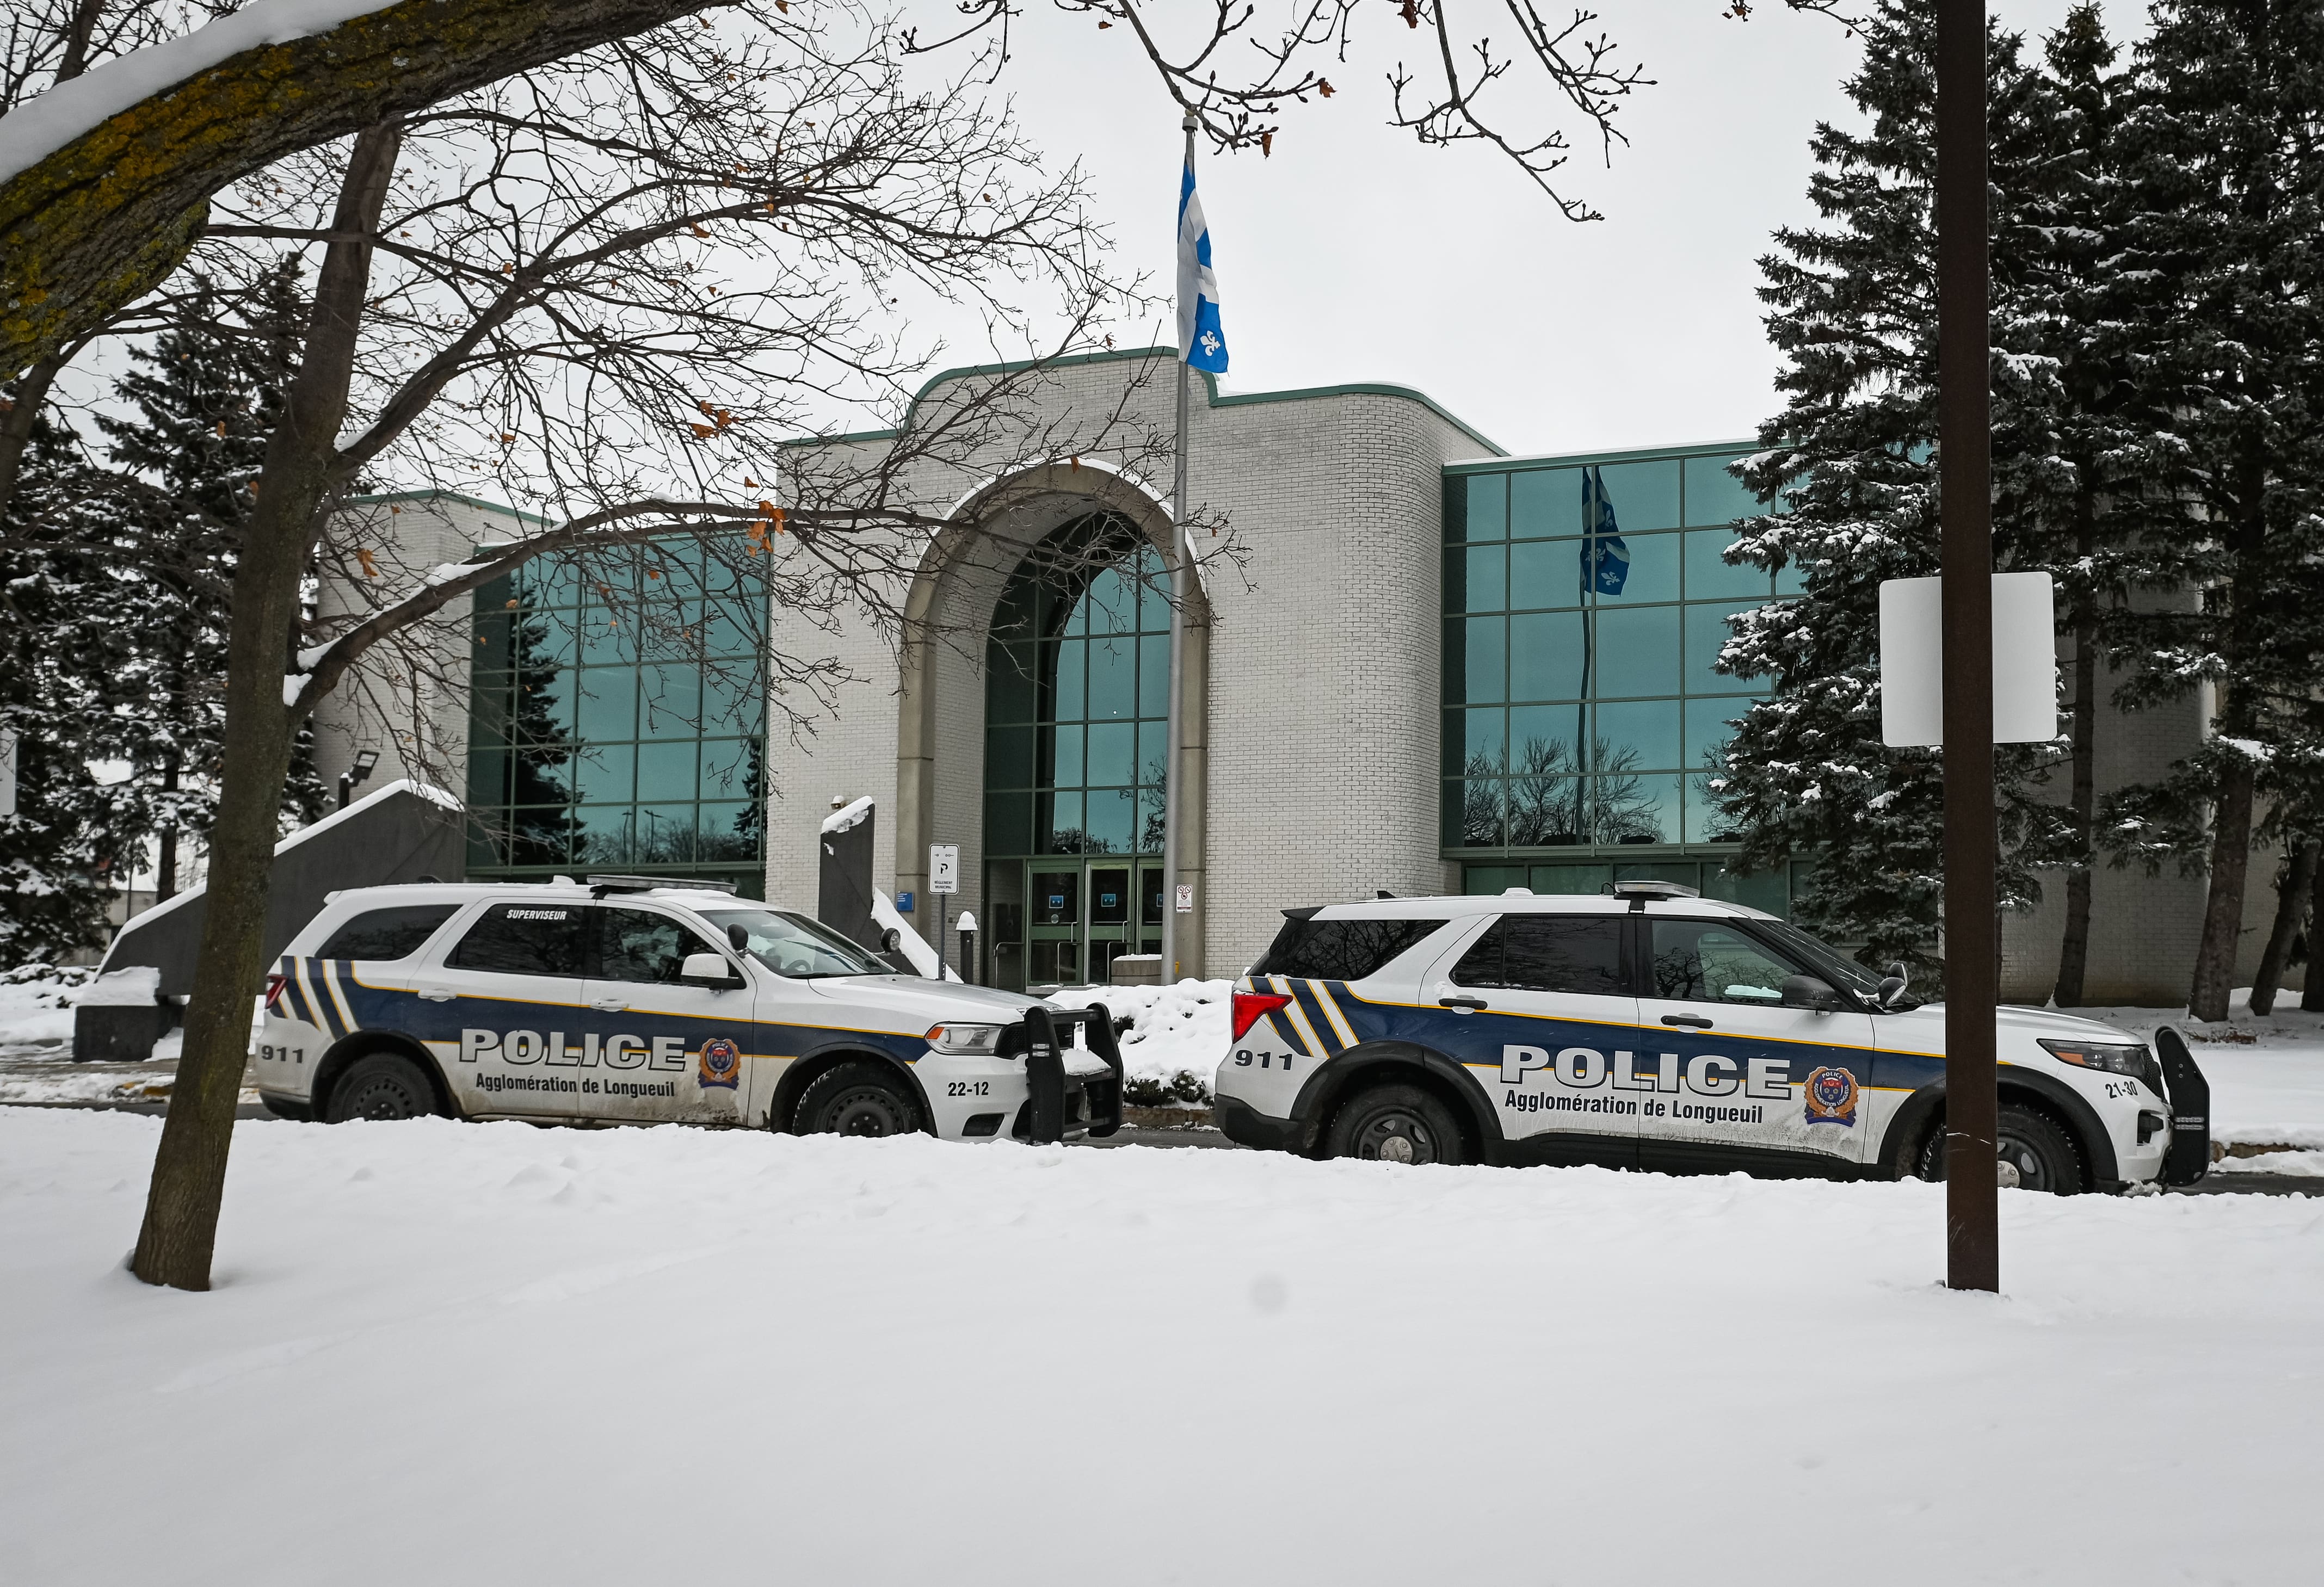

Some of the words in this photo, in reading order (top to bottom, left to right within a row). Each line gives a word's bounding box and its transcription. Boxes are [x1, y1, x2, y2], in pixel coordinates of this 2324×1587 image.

[507, 909, 567, 920] SUPERVISEUR
[261, 1045, 304, 1064] 911
[459, 1028, 687, 1072] POLICE
[1235, 1049, 1293, 1071] 911
[1500, 1044, 1792, 1101] POLICE
[1822, 1071, 1843, 1079] POLICE
[475, 1072, 577, 1093] Agglomération
[582, 1078, 599, 1094] de
[604, 1079, 675, 1098] Longueuil
[948, 1081, 989, 1096] 22-12
[2105, 1080, 2138, 1099] 21-30
[1505, 1089, 1637, 1115] Agglomération
[1643, 1098, 1666, 1117] de
[1672, 1100, 1763, 1124] Longueuil
